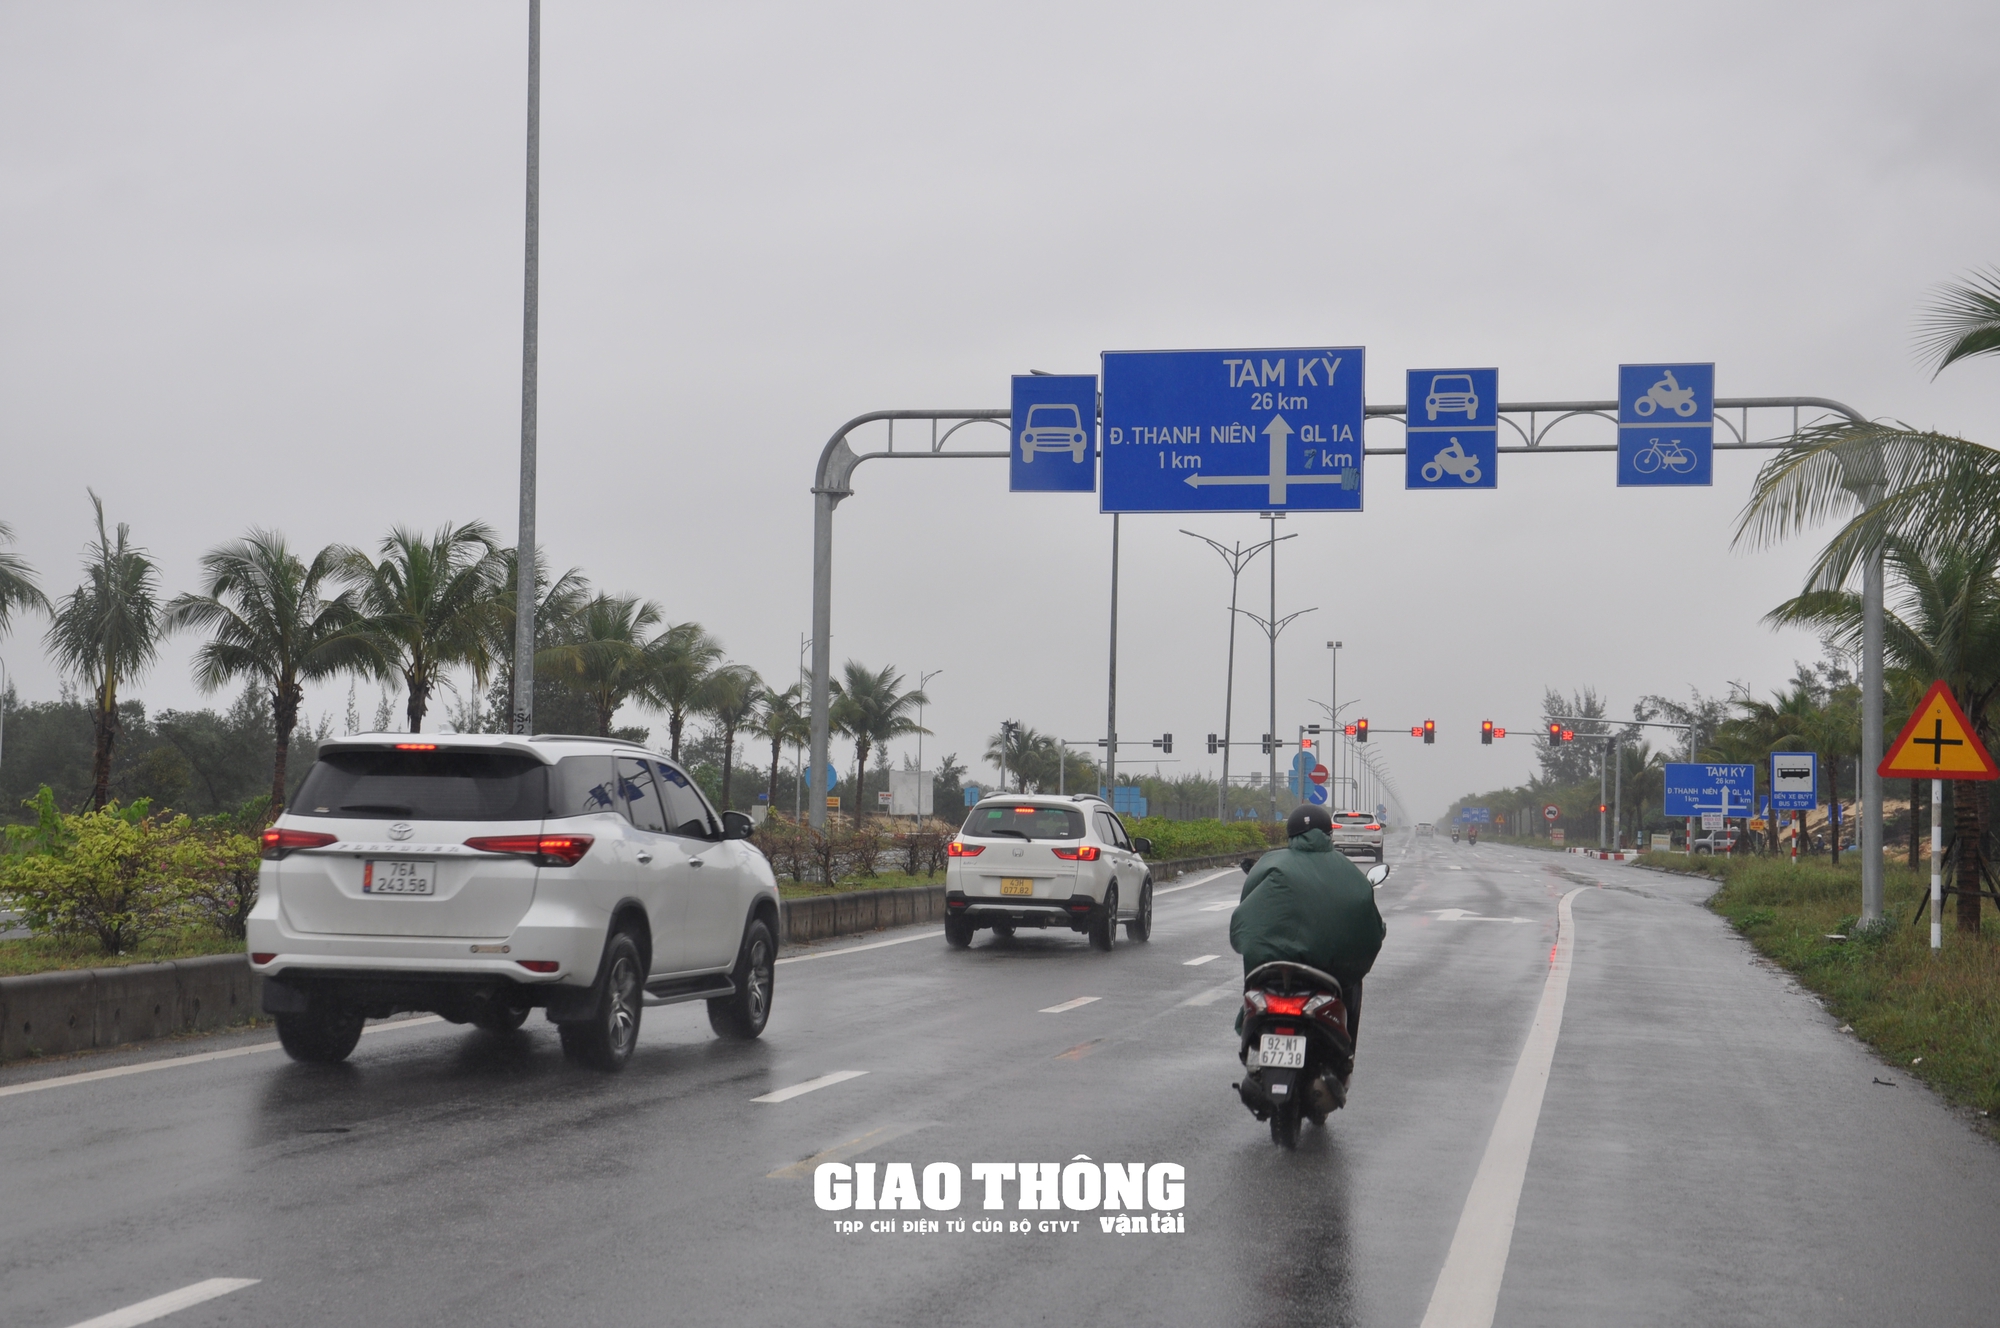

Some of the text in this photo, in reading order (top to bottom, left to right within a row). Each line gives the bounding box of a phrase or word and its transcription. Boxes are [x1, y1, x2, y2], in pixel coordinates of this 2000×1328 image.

[1223, 351, 1342, 388] TAM KỲ
[1251, 392, 1308, 411] 26 km
[1210, 422, 1256, 443] NIÊN
[1300, 424, 1354, 443] QL 1A
[1158, 452, 1201, 469] 1 km
[1322, 449, 1353, 468] km
[1345, 726, 1356, 735] 32
[1412, 727, 1423, 737] 32
[1494, 728, 1505, 738] 32
[1562, 730, 1574, 740] 32
[1706, 765, 1746, 777] TAM KỲ
[1724, 777, 1736, 785] km
[1702, 787, 1718, 795] NIÊN
[1732, 788, 1742, 796] QL
[390, 863, 416, 876] 76A
[377, 878, 427, 892] 243.58
[1009, 879, 1024, 887] 43H
[1267, 1037, 1298, 1051] 92-N1
[1262, 1051, 1302, 1066] 677.38
